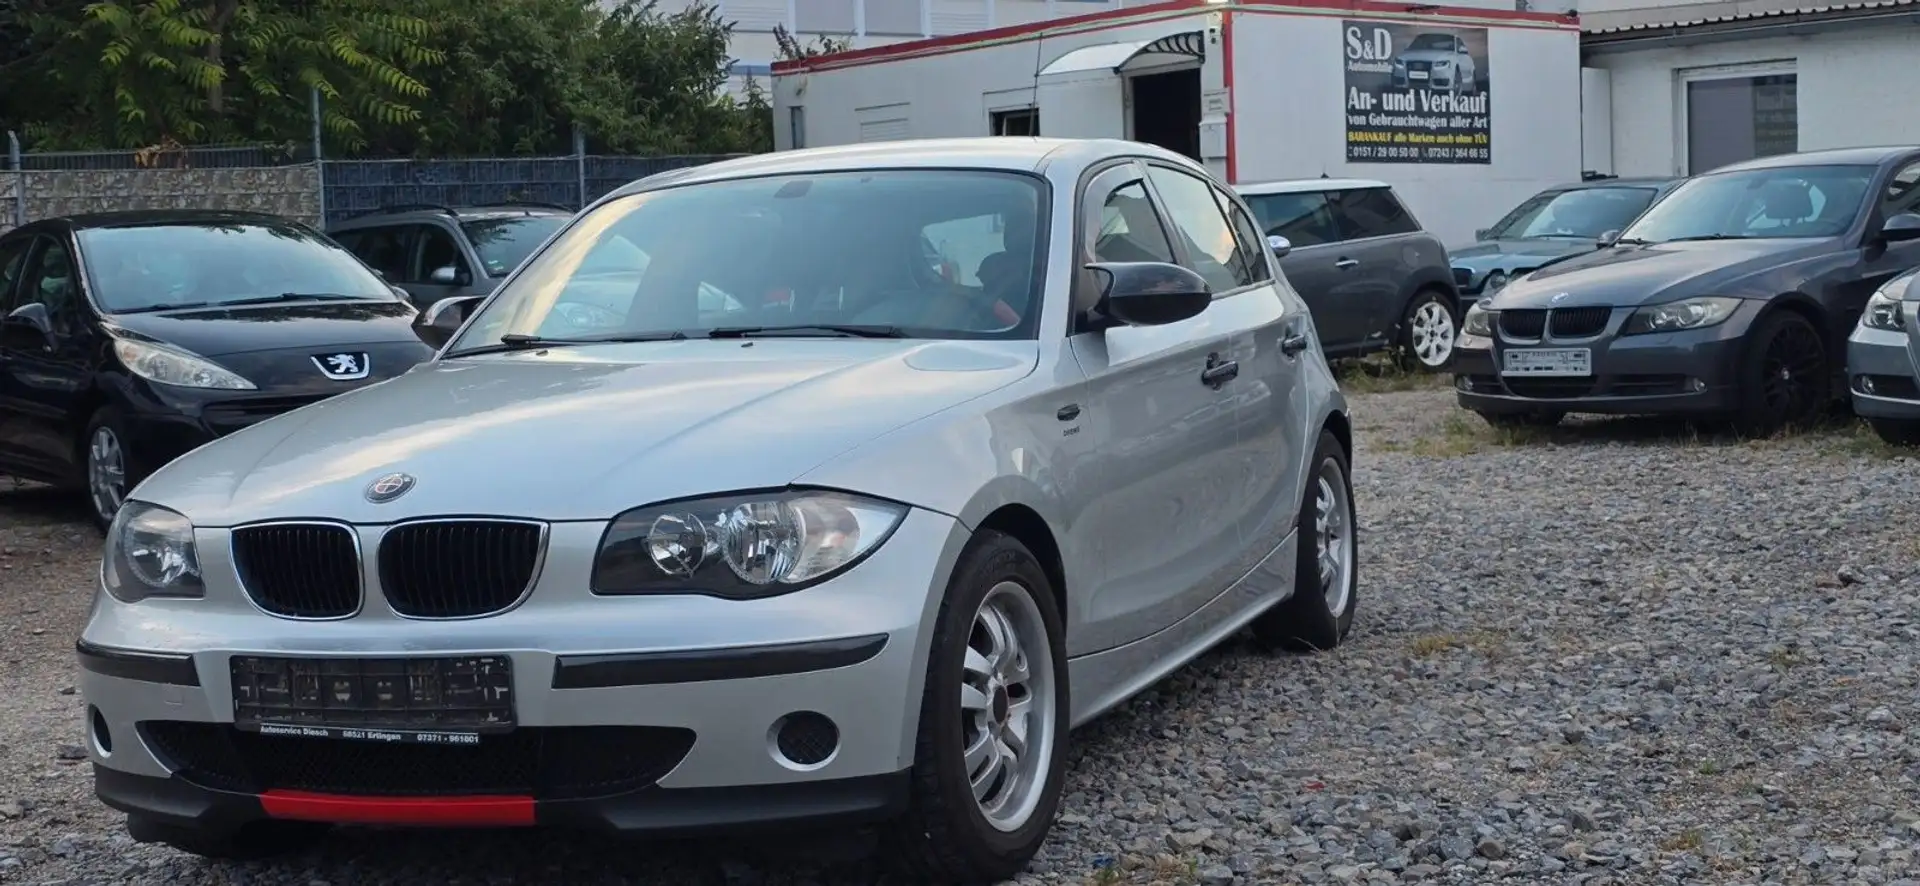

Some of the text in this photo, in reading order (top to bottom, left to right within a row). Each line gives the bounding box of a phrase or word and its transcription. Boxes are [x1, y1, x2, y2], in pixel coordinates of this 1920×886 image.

[1346, 26, 1392, 60] S&D
[1347, 86, 1488, 113] An- und Verkauf
[1347, 113, 1488, 129] von Gebrauchtwagen aller Art
[1348, 131, 1488, 144] BARANKAUF alle Marken auch ohne TÜV
[1353, 147, 1372, 158] 0151
